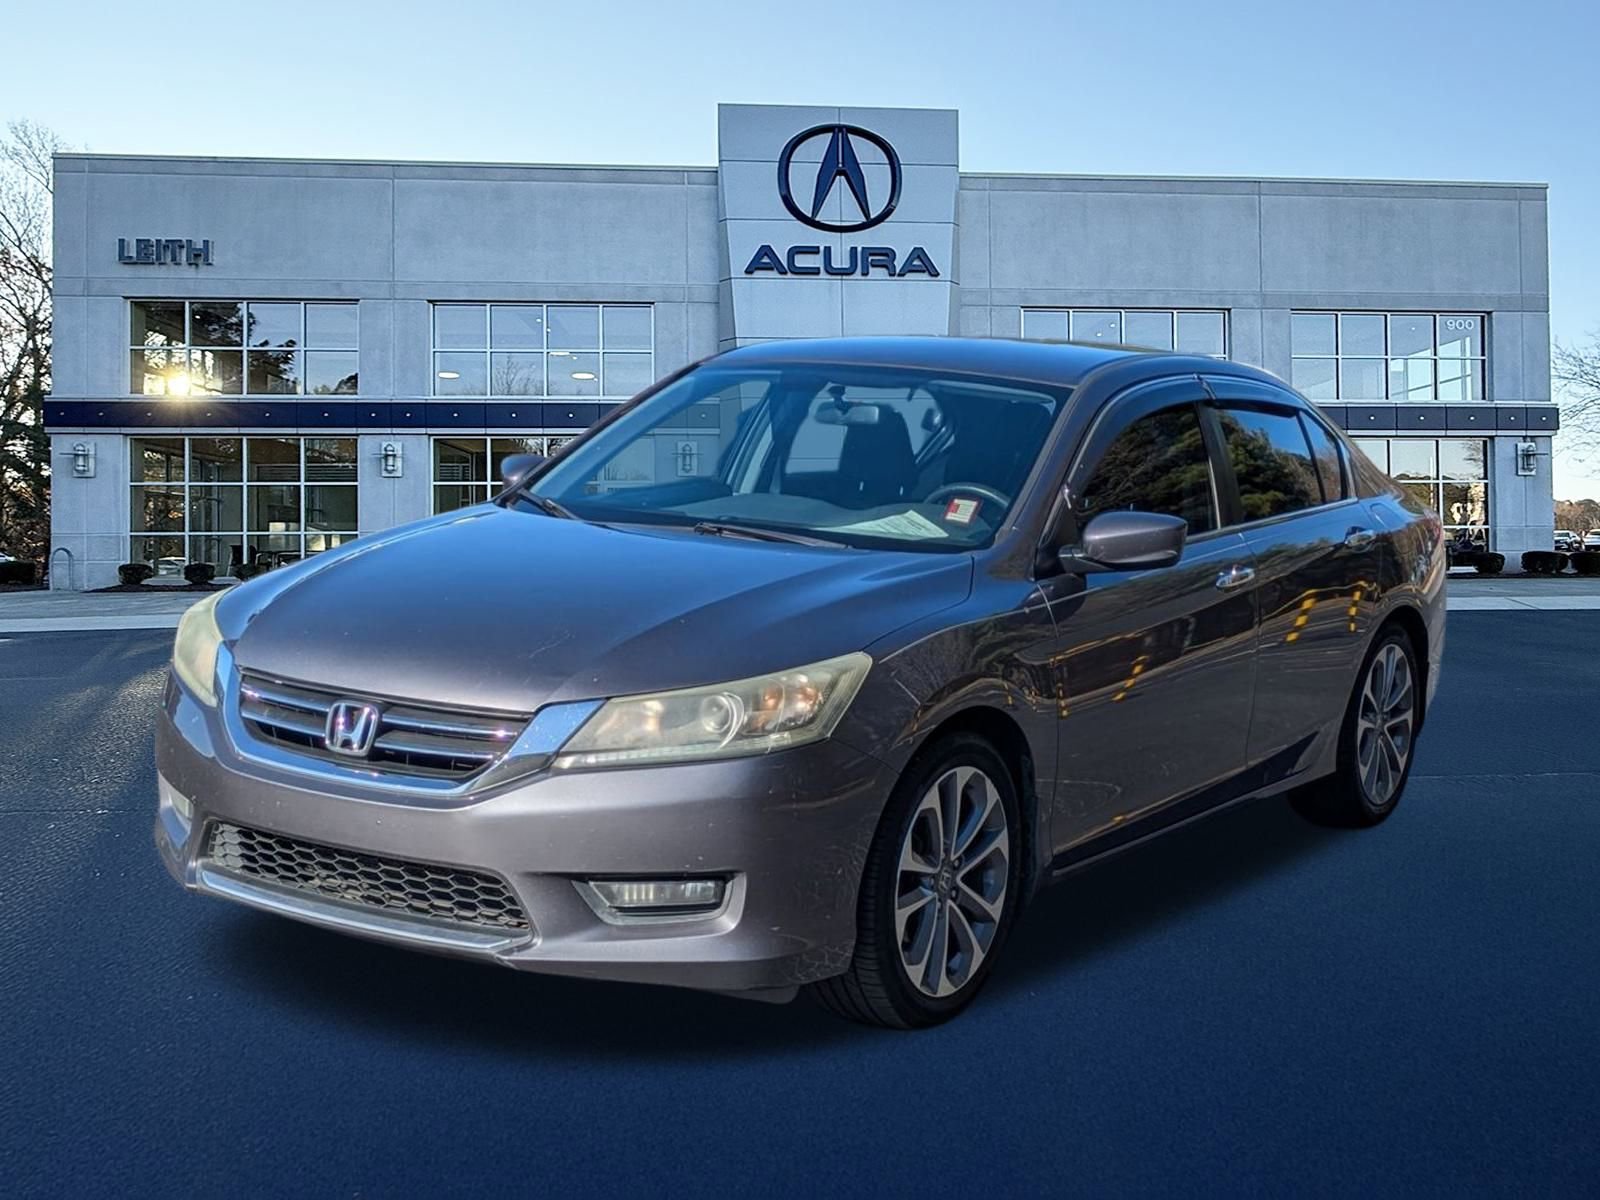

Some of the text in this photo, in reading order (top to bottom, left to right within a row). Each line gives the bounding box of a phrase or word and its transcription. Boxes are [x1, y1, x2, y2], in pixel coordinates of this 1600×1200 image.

[118, 238, 211, 264] LEITH
[744, 244, 940, 277] ACURA
[1446, 319, 1474, 330] 900
